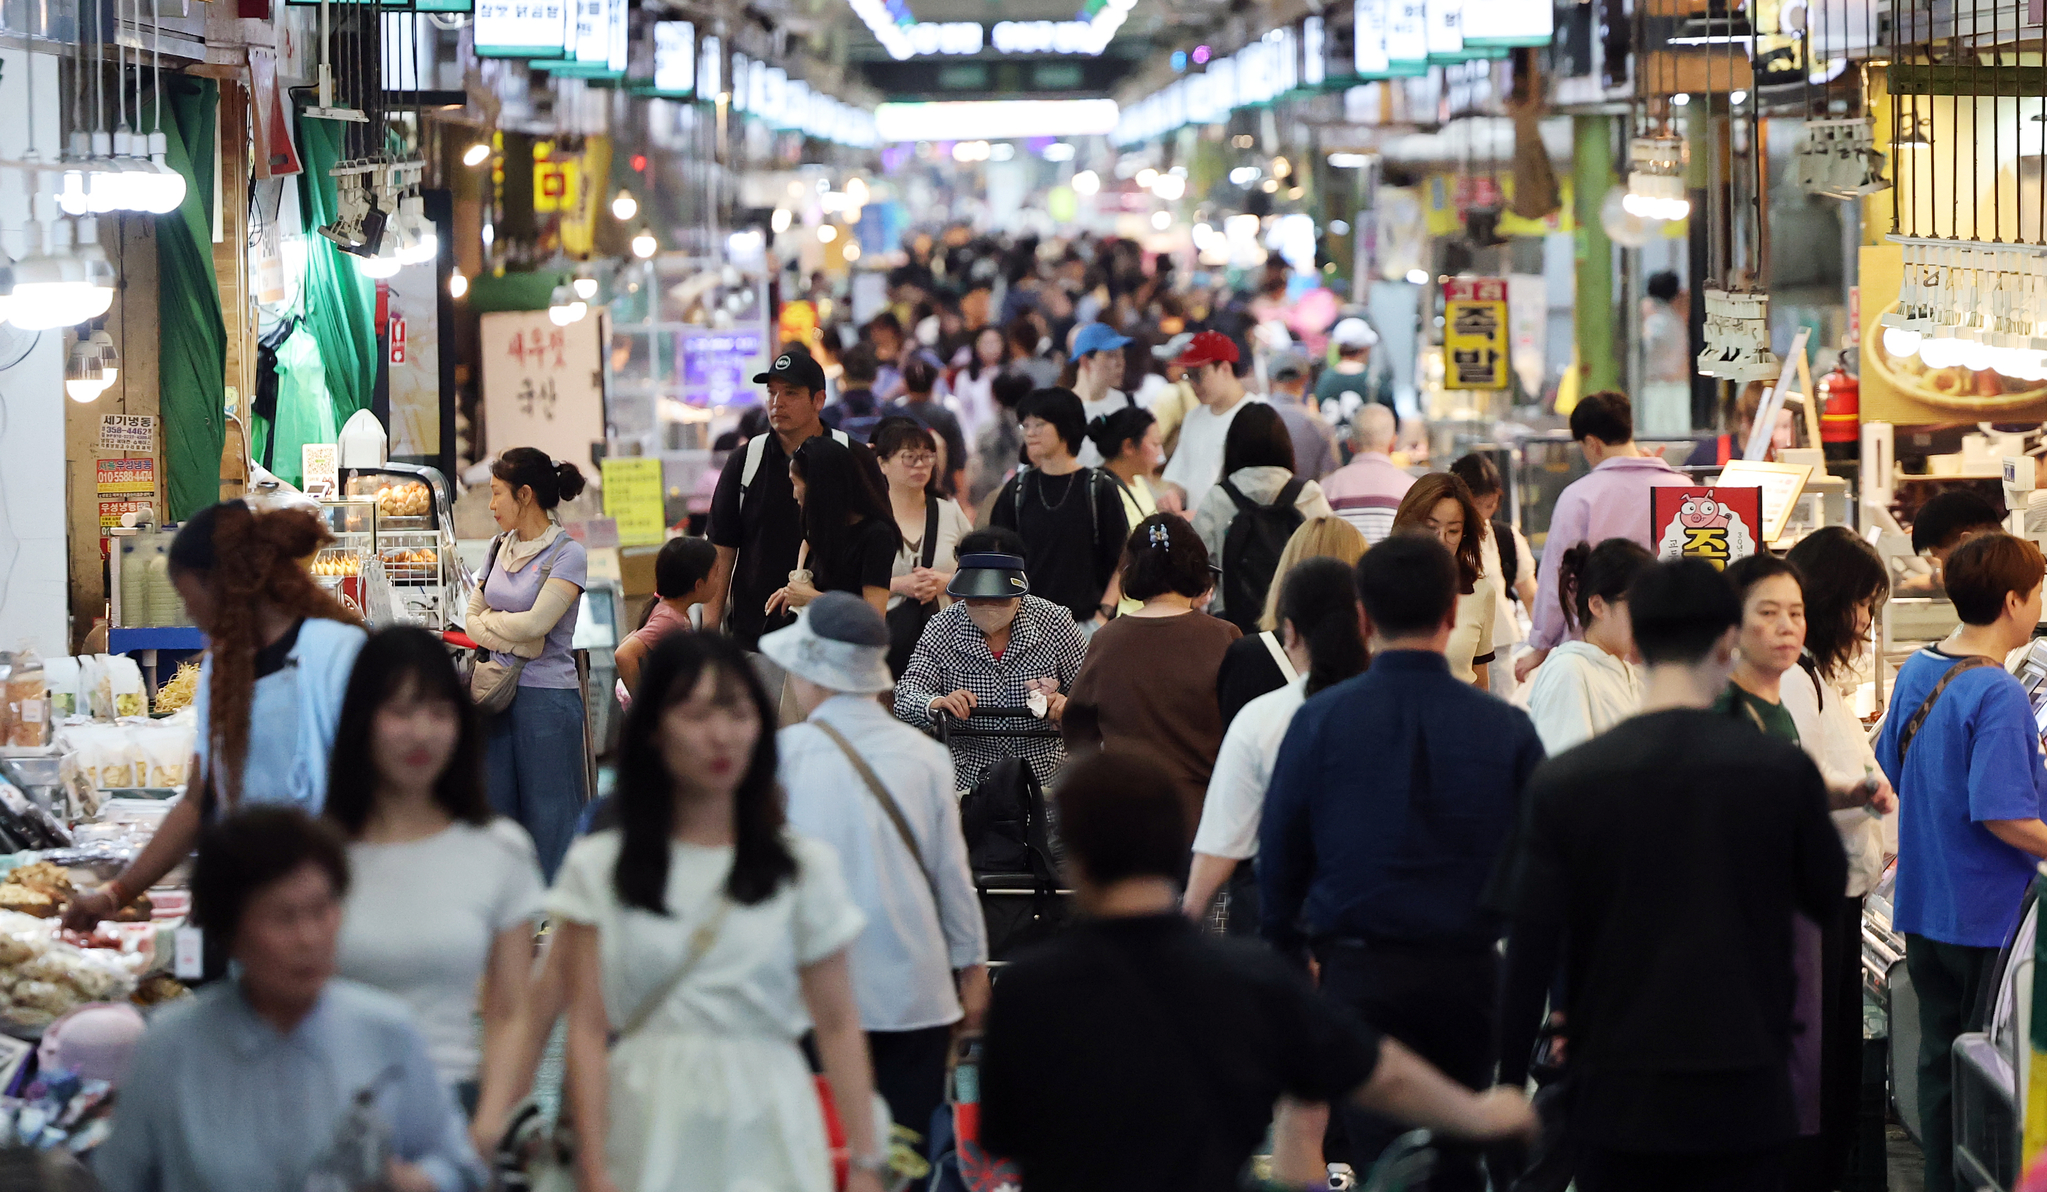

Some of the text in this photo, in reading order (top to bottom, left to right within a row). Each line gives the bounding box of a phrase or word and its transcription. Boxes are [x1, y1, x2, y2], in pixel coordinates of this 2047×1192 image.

[1454, 306, 1499, 382] 족발
[517, 377, 556, 421] 국산
[103, 415, 151, 427] 세기냉동
[106, 426, 148, 435] 358-4462
